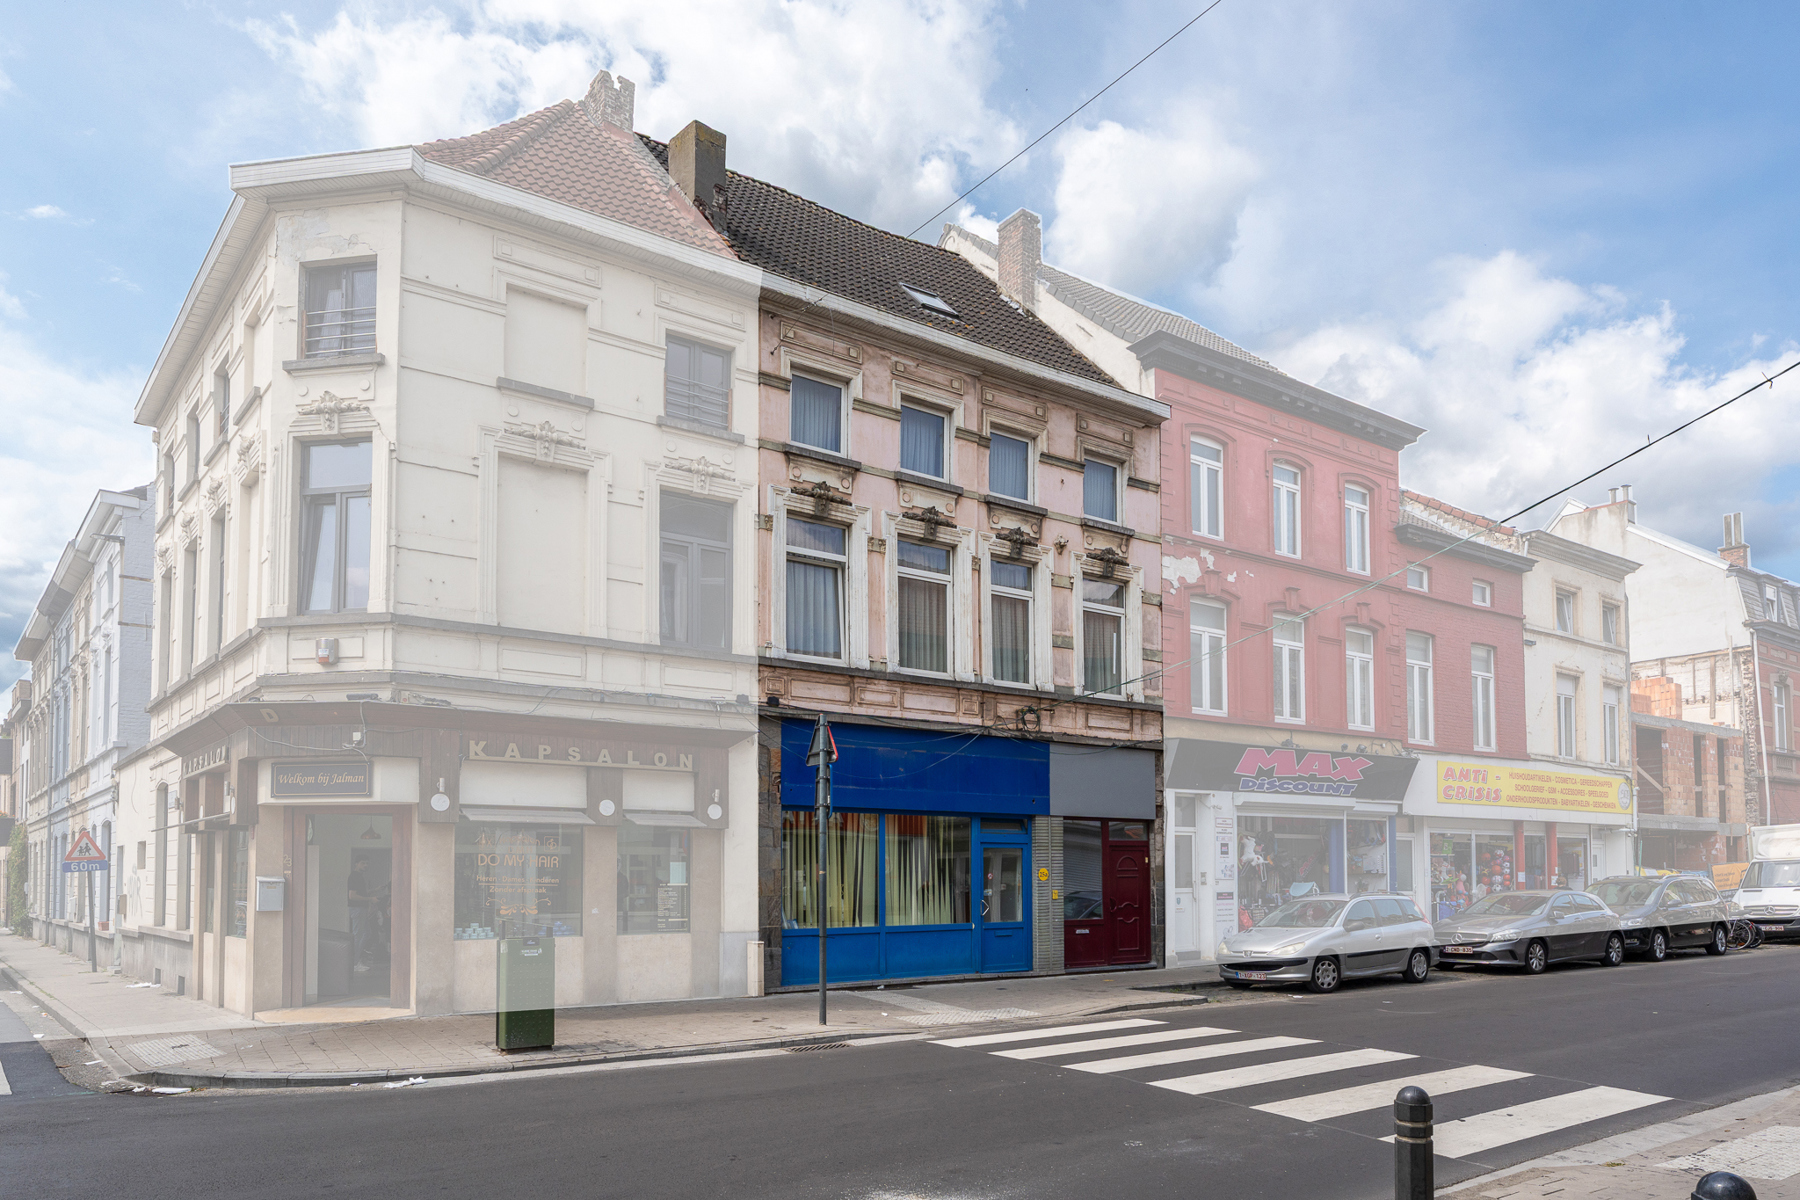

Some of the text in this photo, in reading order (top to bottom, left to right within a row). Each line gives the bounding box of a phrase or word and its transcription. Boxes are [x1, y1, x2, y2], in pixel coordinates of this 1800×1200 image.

[260, 709, 279, 722] D
[469, 740, 693, 770] KAPSALON
[1233, 747, 1374, 782] MAX
[278, 772, 364, 787] Welkom bij Jalman
[1508, 772, 1613, 788] HUISHOUDARTIKELEN COSMETICA GEREEDSCHAPPEN
[1514, 783, 1545, 793] SCHOOLGERIEF
[1547, 787, 1557, 795] GSM
[1560, 788, 1586, 797] ACCESSOIRES
[1587, 790, 1609, 799] SPEELGOED
[1506, 794, 1616, 810] ONDERHOUDSPRODUKTEN BABYARTIKELEN GESCHENKEN
[283, 854, 292, 867] 23
[478, 853, 559, 868] DO MY HAIR
[476, 874, 497, 882] Heren
[489, 885, 547, 895] Zonder afspraak
